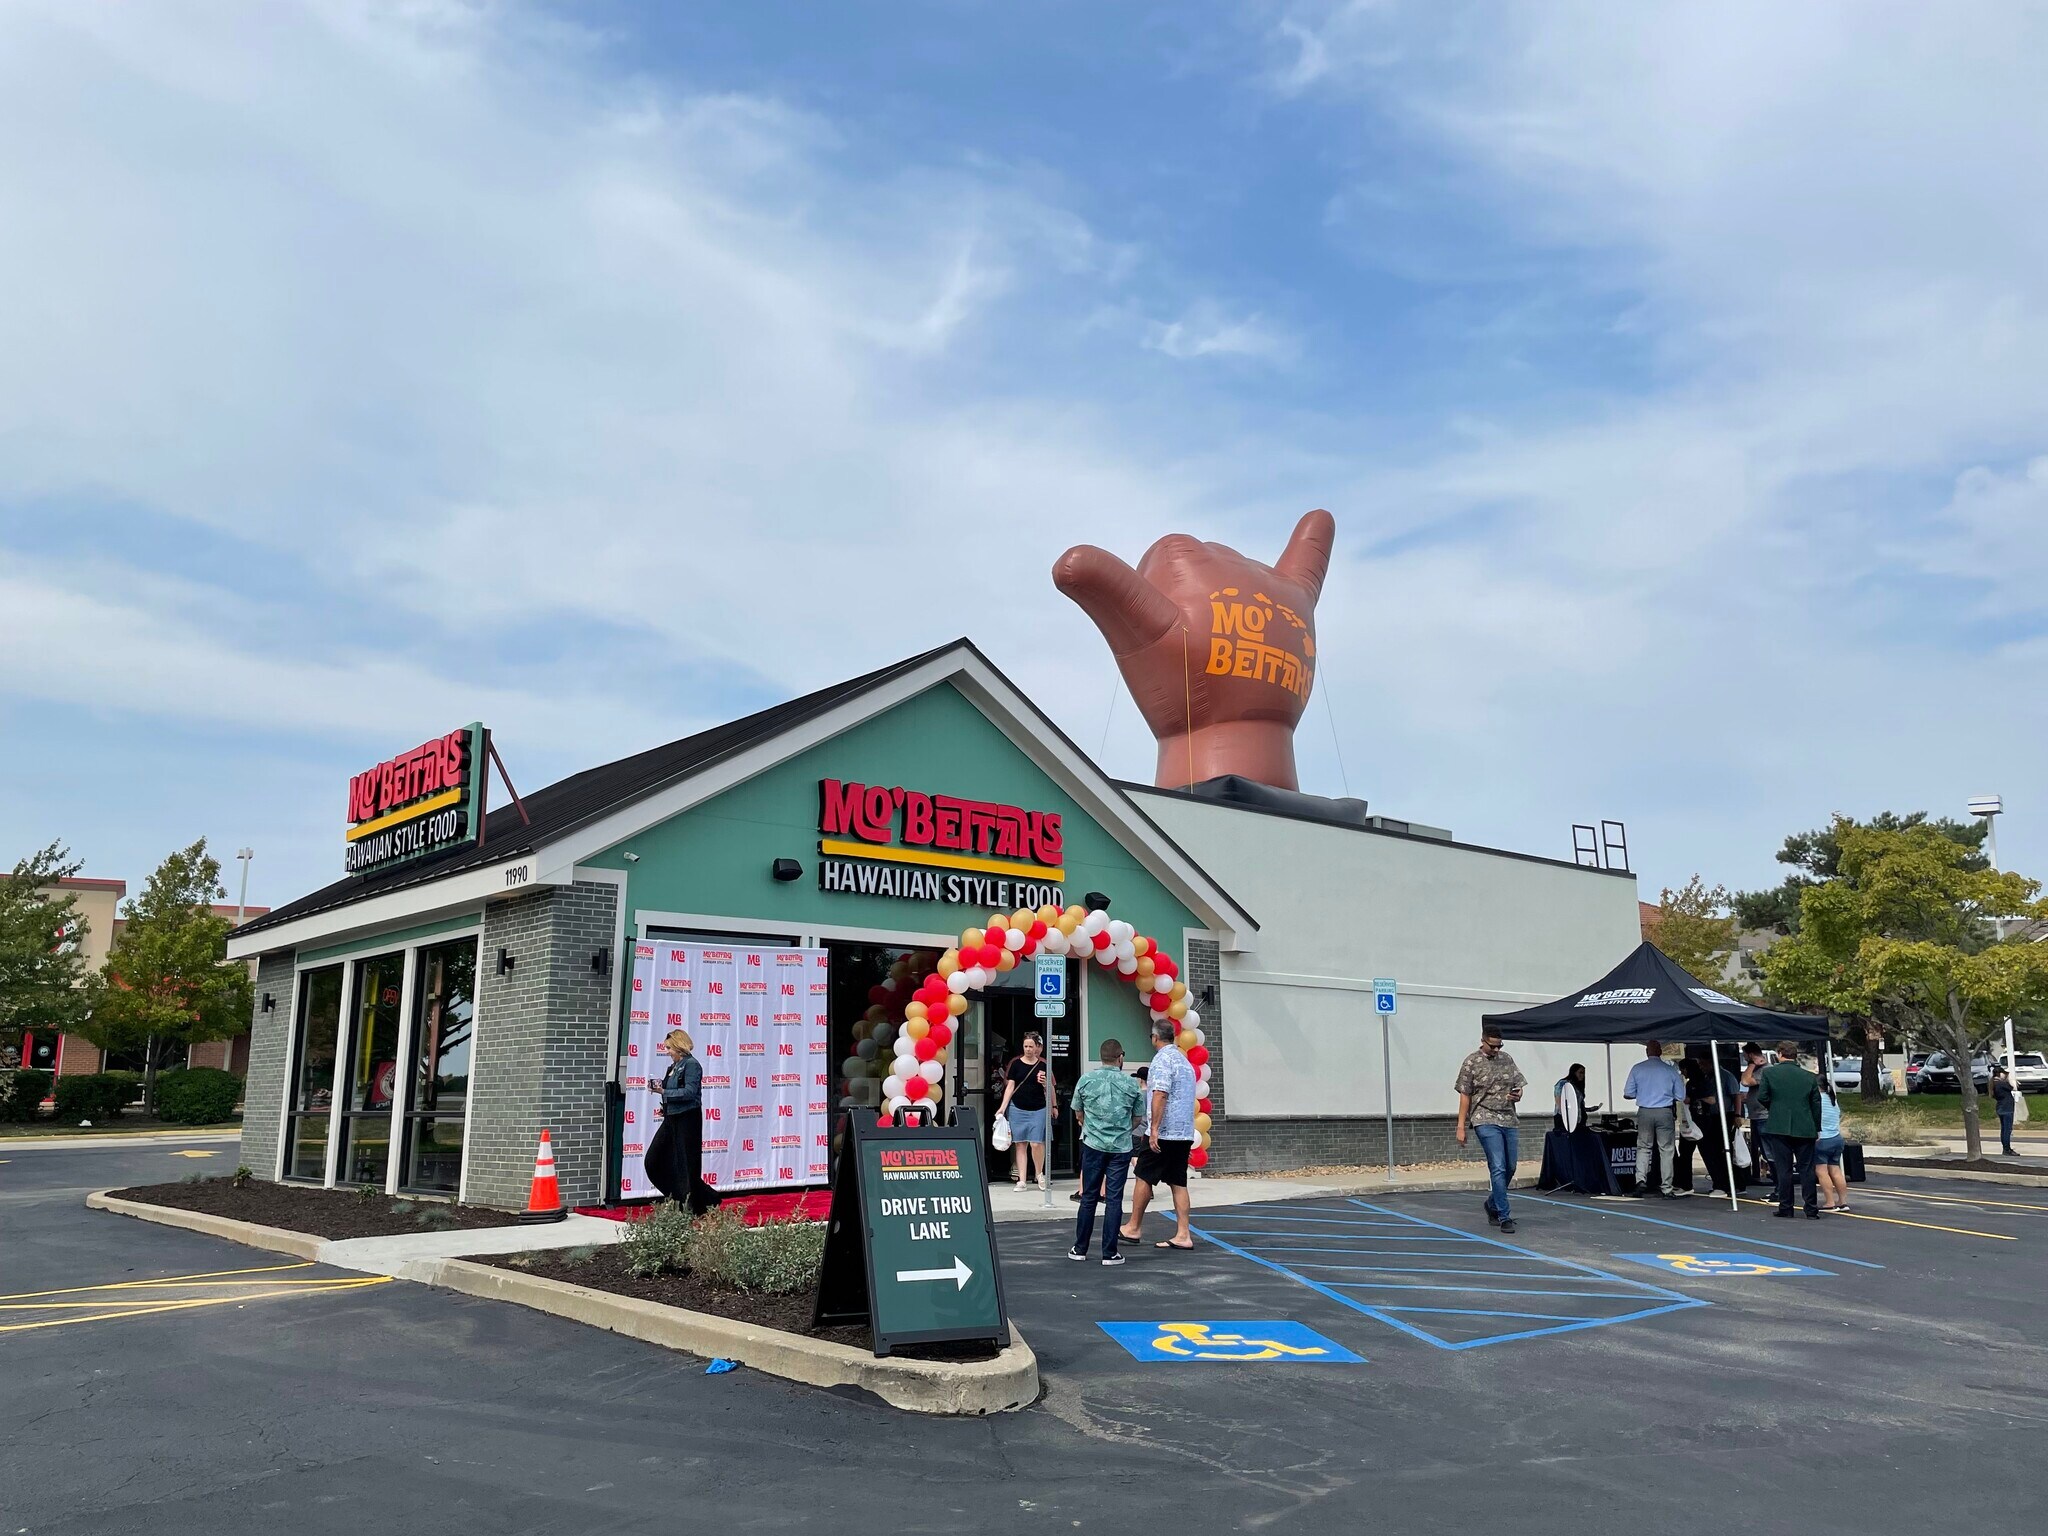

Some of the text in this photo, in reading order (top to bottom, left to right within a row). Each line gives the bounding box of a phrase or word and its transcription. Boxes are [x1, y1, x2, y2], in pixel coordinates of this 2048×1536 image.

[1210, 601, 1273, 643] MO'
[347, 728, 464, 823] MO'BETTAHS
[819, 778, 1063, 866] MO'BETTAHS
[345, 809, 458, 872] HAWAIIAN STYLE FOOD
[505, 864, 528, 886] 11990
[823, 860, 1064, 911] HAWAIIAN STYLE FOOD
[880, 1149, 958, 1167] MO'BETTAHS
[1611, 1147, 1638, 1162] MO'BE
[883, 1172, 919, 1181] HAWAIIAN
[920, 1171, 941, 1180] STYLE
[881, 1196, 972, 1216] DRIVE THRU
[910, 1222, 951, 1240] LANE
